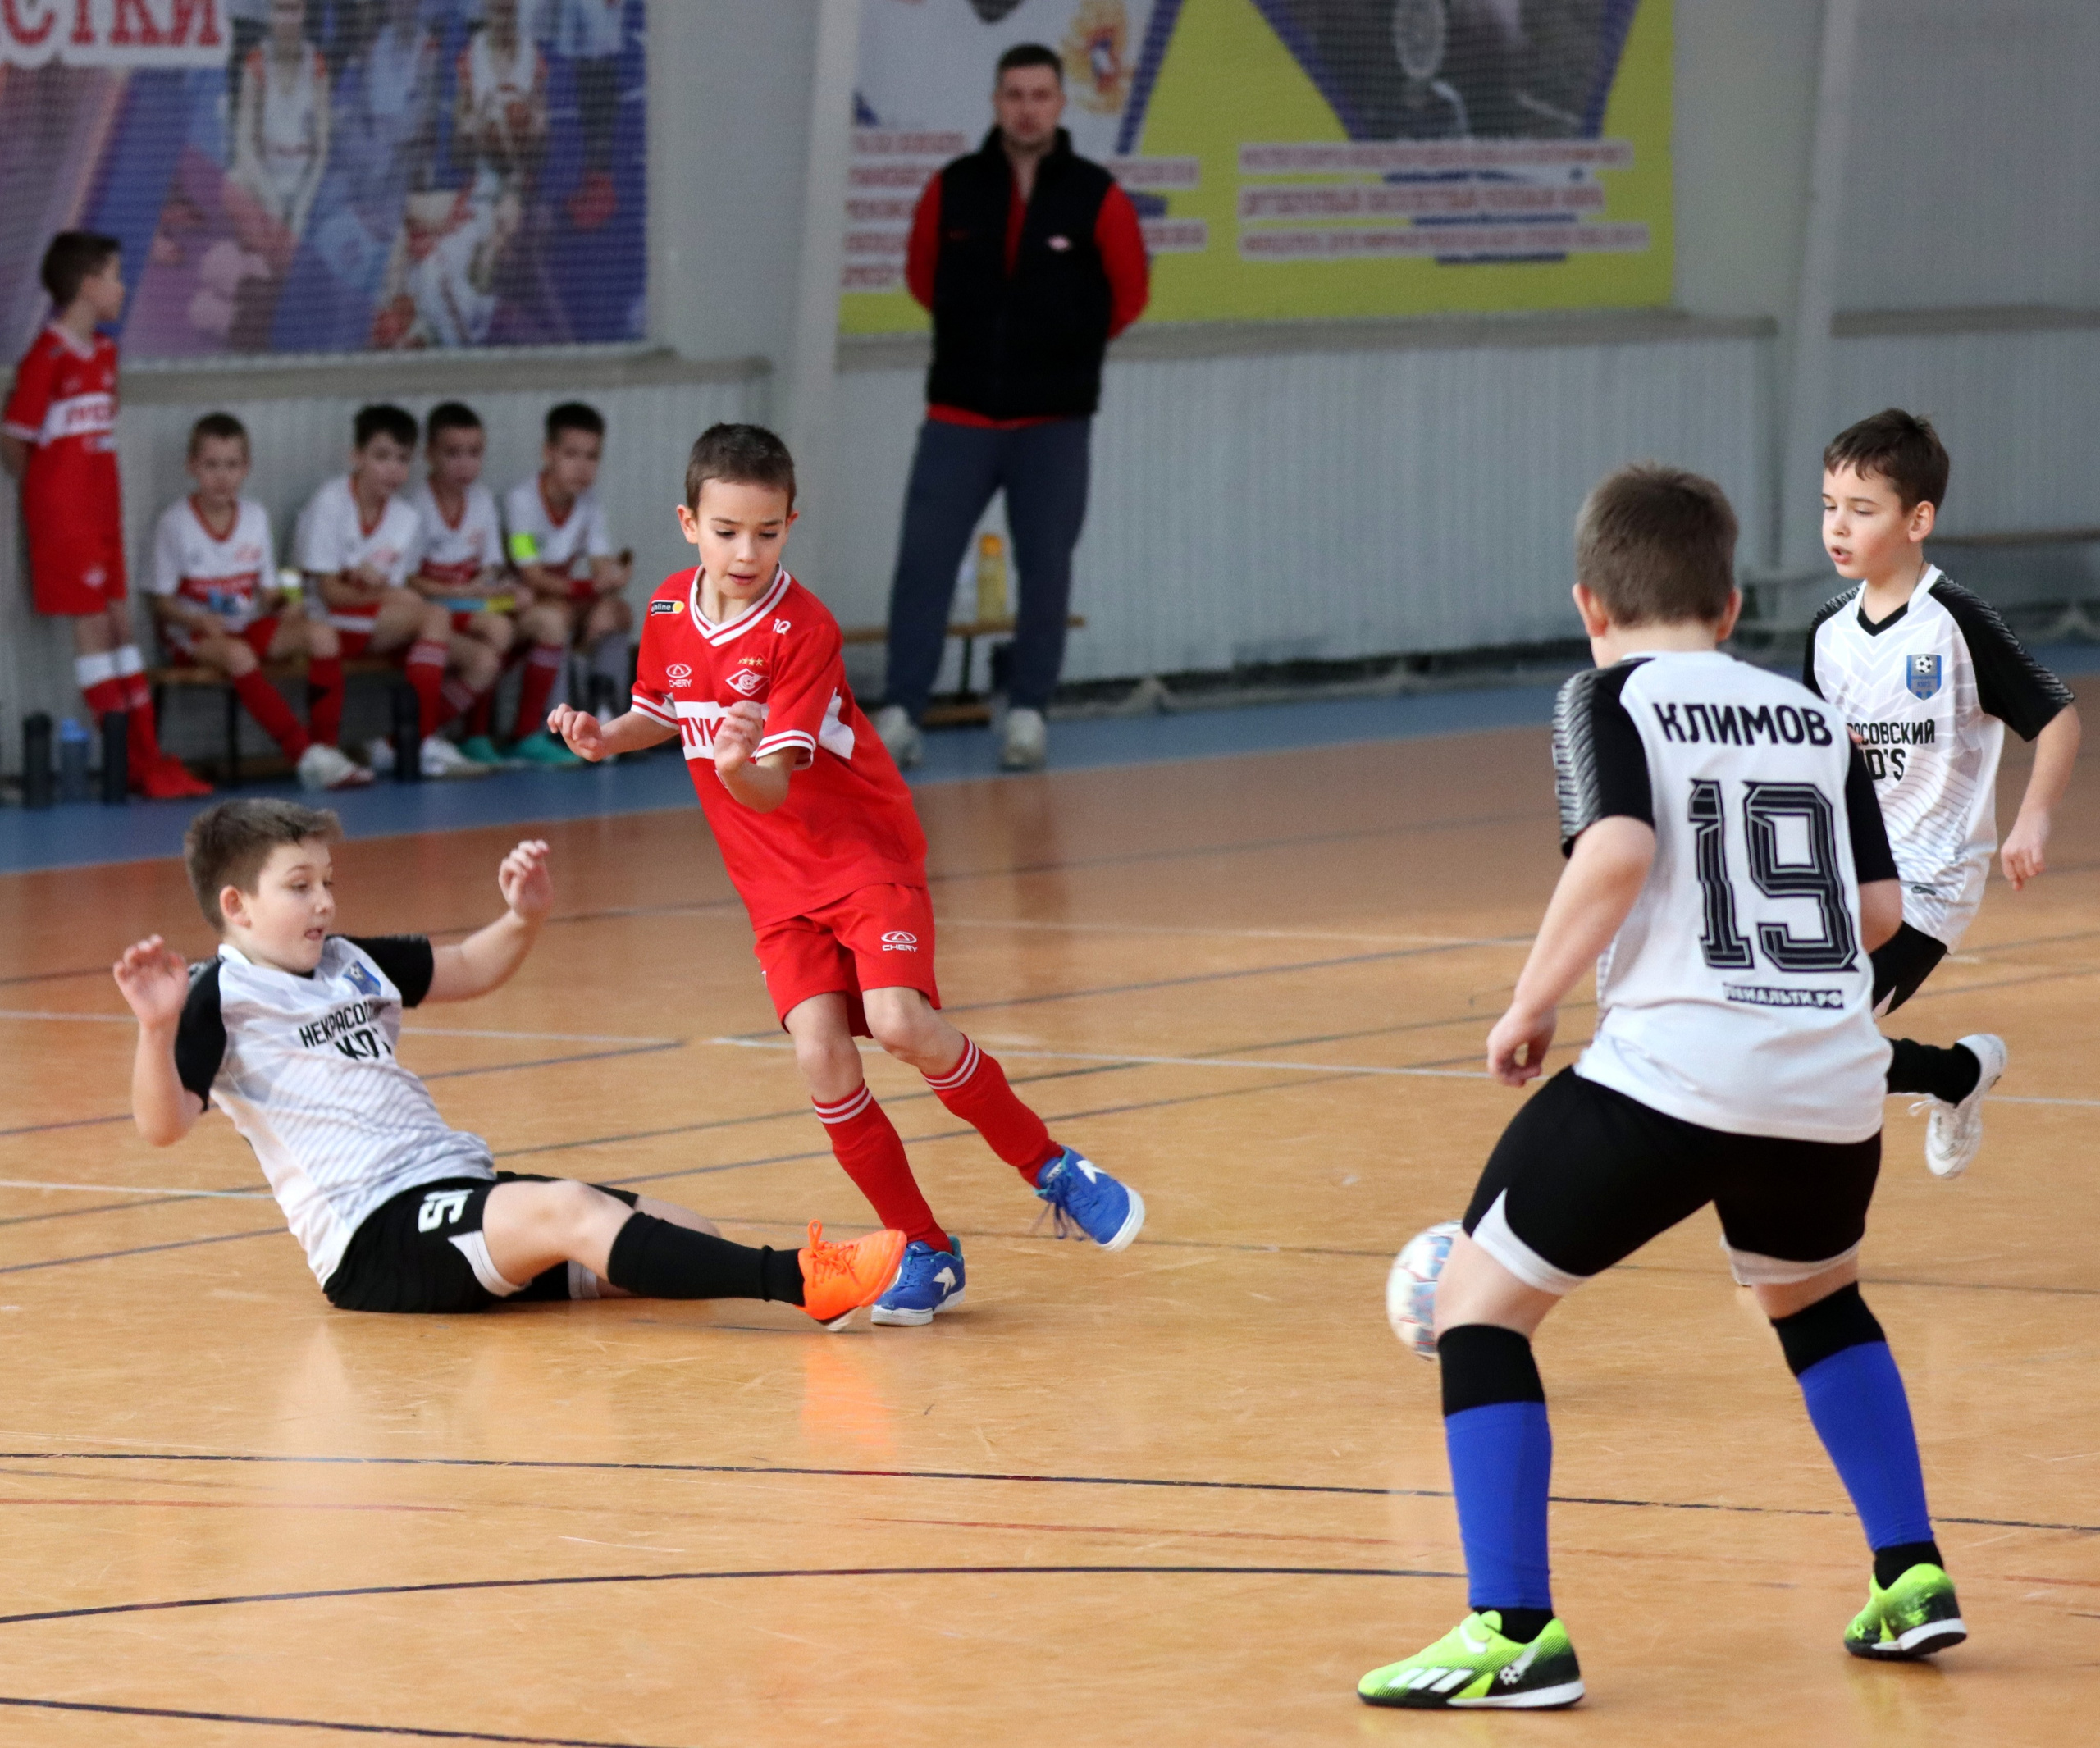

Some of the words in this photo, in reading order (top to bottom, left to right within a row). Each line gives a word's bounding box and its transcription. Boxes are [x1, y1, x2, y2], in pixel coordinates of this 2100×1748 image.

[668, 678, 692, 688] CHERY
[1652, 702, 1833, 746] КЛИМОВ
[1687, 778, 1860, 974] 19
[881, 943, 918, 952] CHERY
